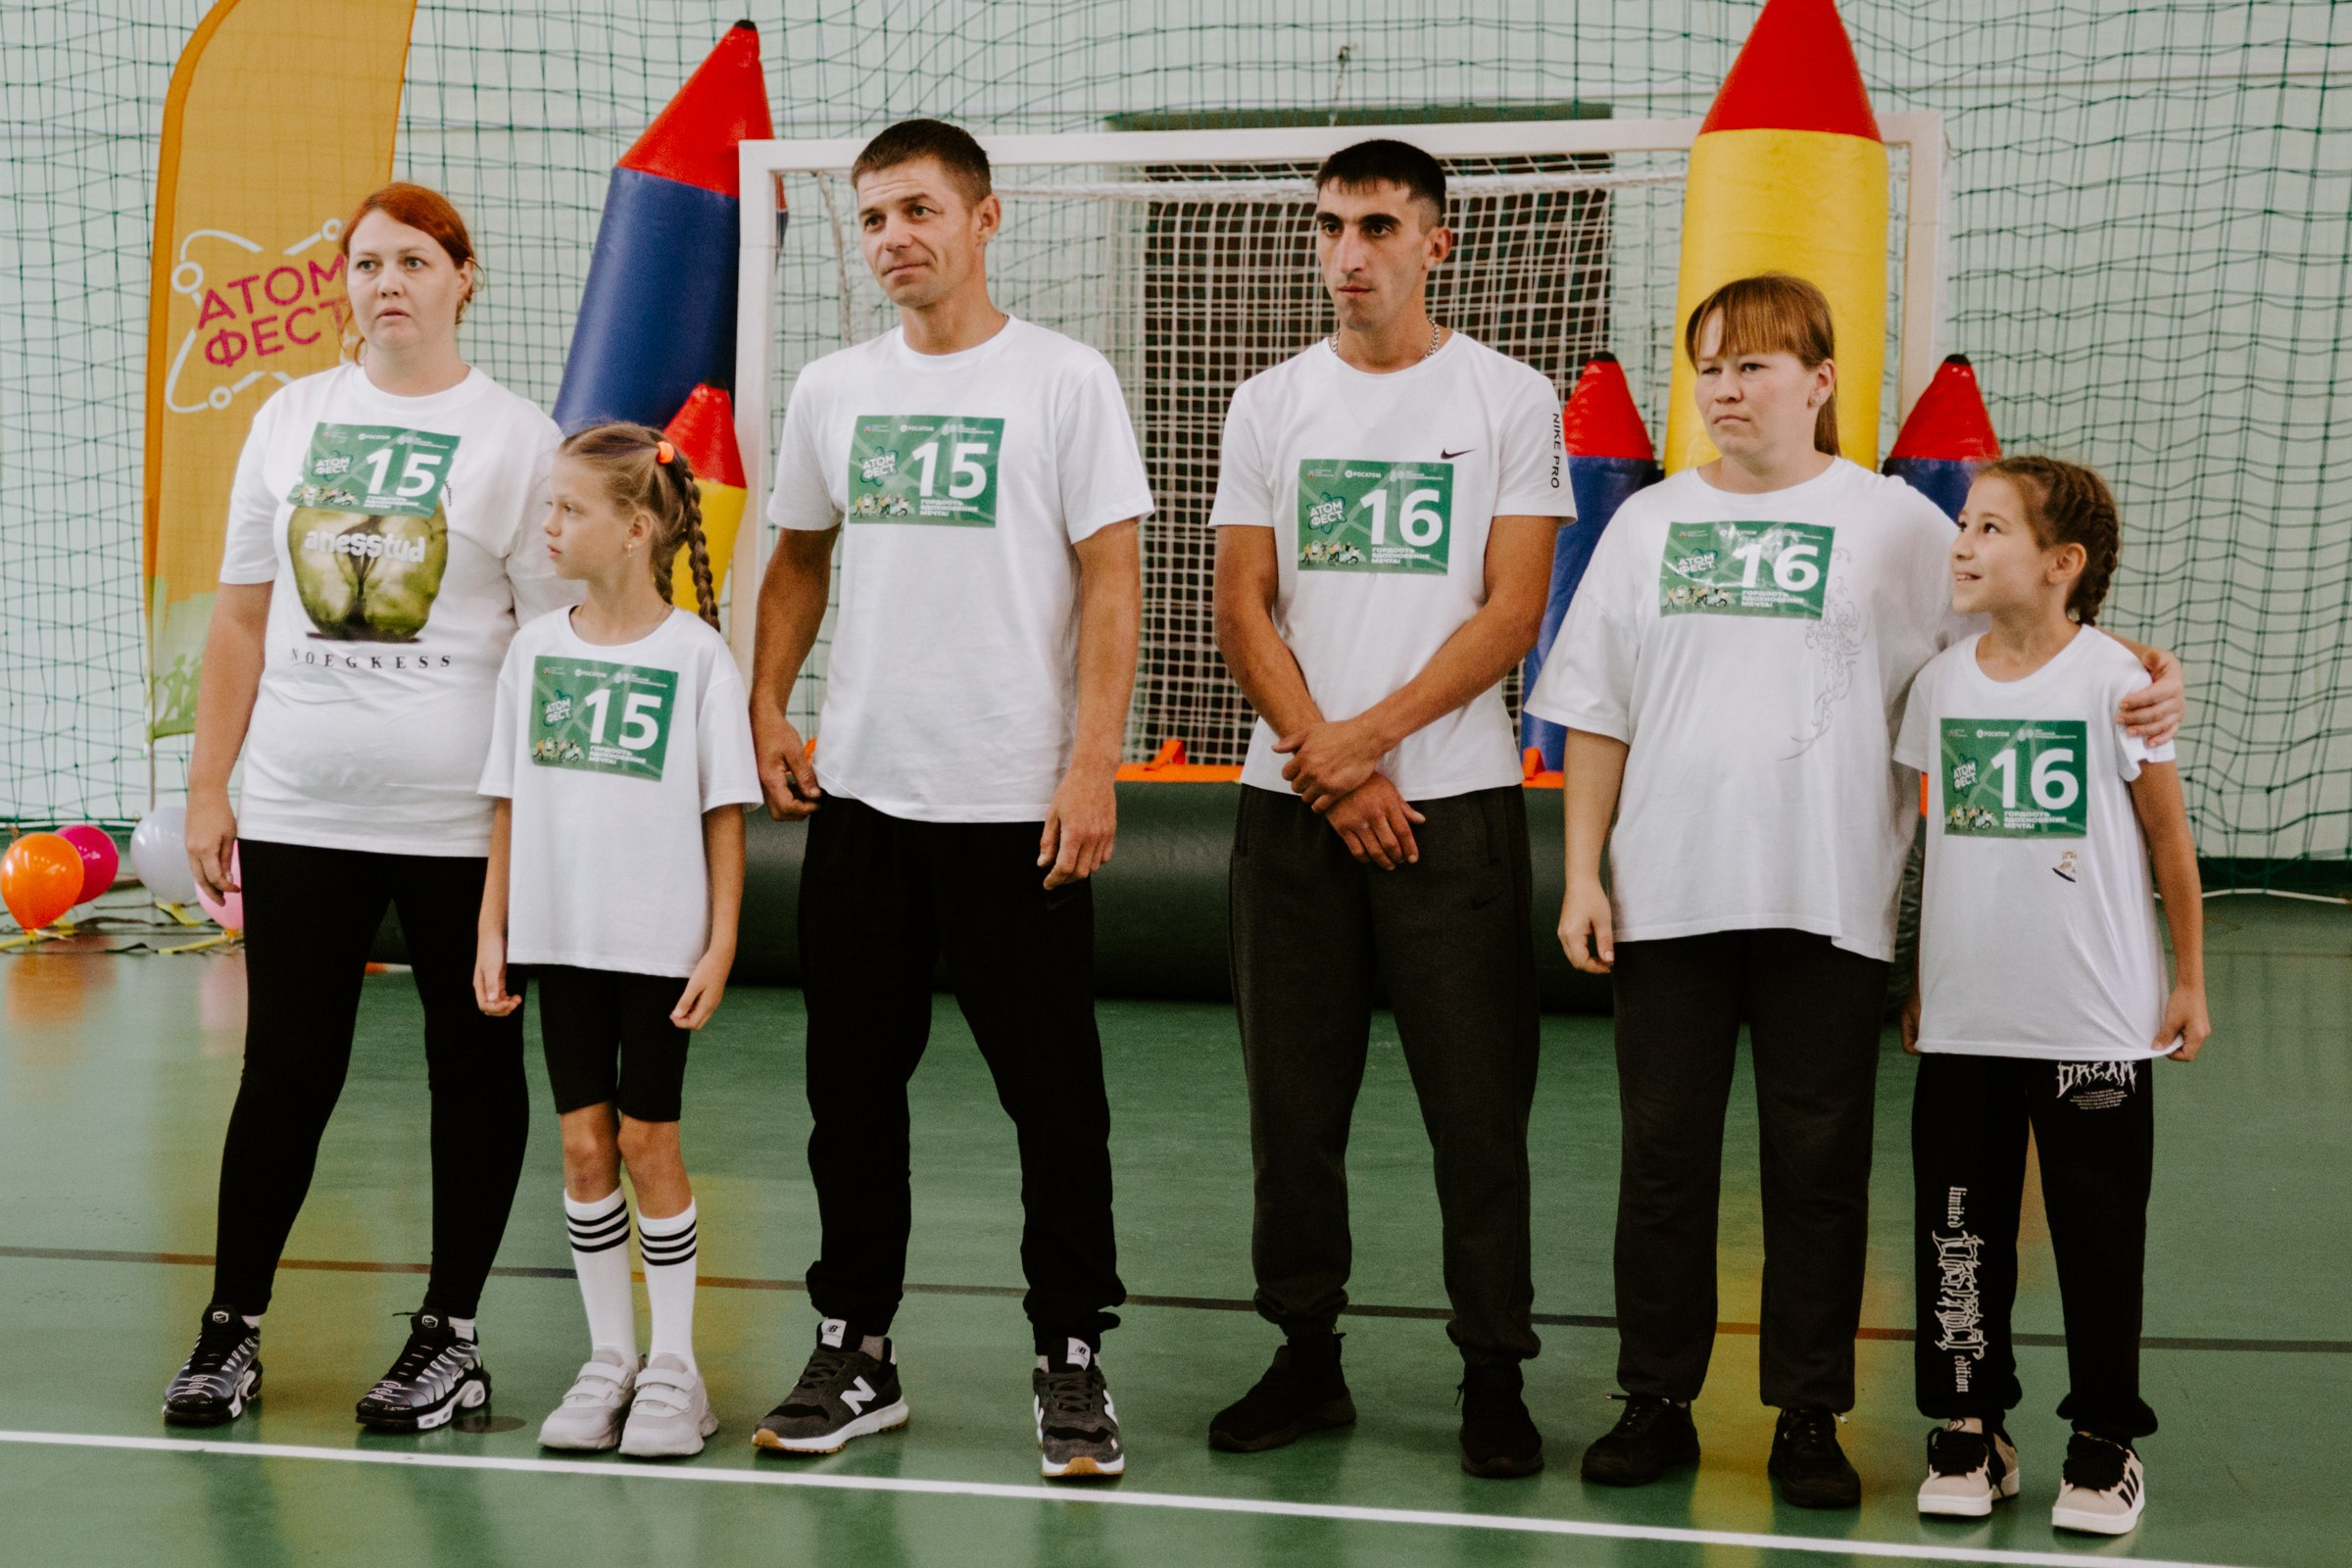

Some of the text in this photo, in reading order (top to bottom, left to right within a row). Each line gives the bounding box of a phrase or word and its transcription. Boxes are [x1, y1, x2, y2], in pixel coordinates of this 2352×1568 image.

[199, 253, 345, 330] АТОМ
[204, 297, 351, 368] ФЕСТ
[316, 458, 350, 467] АТОМ
[862, 455, 896, 469] АТОМ
[1550, 413, 1561, 488] NIKE PRO
[316, 466, 350, 474] ФЕСТ
[367, 448, 442, 497] 15
[862, 466, 896, 478] ФЕСТ
[911, 442, 989, 500] 15
[1309, 501, 1343, 517] АТОМ
[1310, 512, 1344, 526] ФЕСТ
[1360, 489, 1443, 547] 16
[304, 529, 425, 563] anesstud
[1679, 554, 1714, 565] АТОМ
[1679, 562, 1714, 573] ФЕСТ
[1732, 544, 1820, 591] 16
[291, 647, 452, 670] NOEGKESS
[546, 698, 570, 713] АТОМ
[546, 708, 570, 723] ФЕСТ
[585, 688, 662, 751] 15
[1953, 761, 1976, 780] АТОМ
[1954, 773, 1977, 790] ФЕСТ
[1991, 748, 2079, 810] 16
[2056, 1060, 2137, 1098] DREAM
[1947, 1186, 1968, 1228] limited
[1954, 1355, 1972, 1393] edition
[839, 1375, 877, 1415] N
